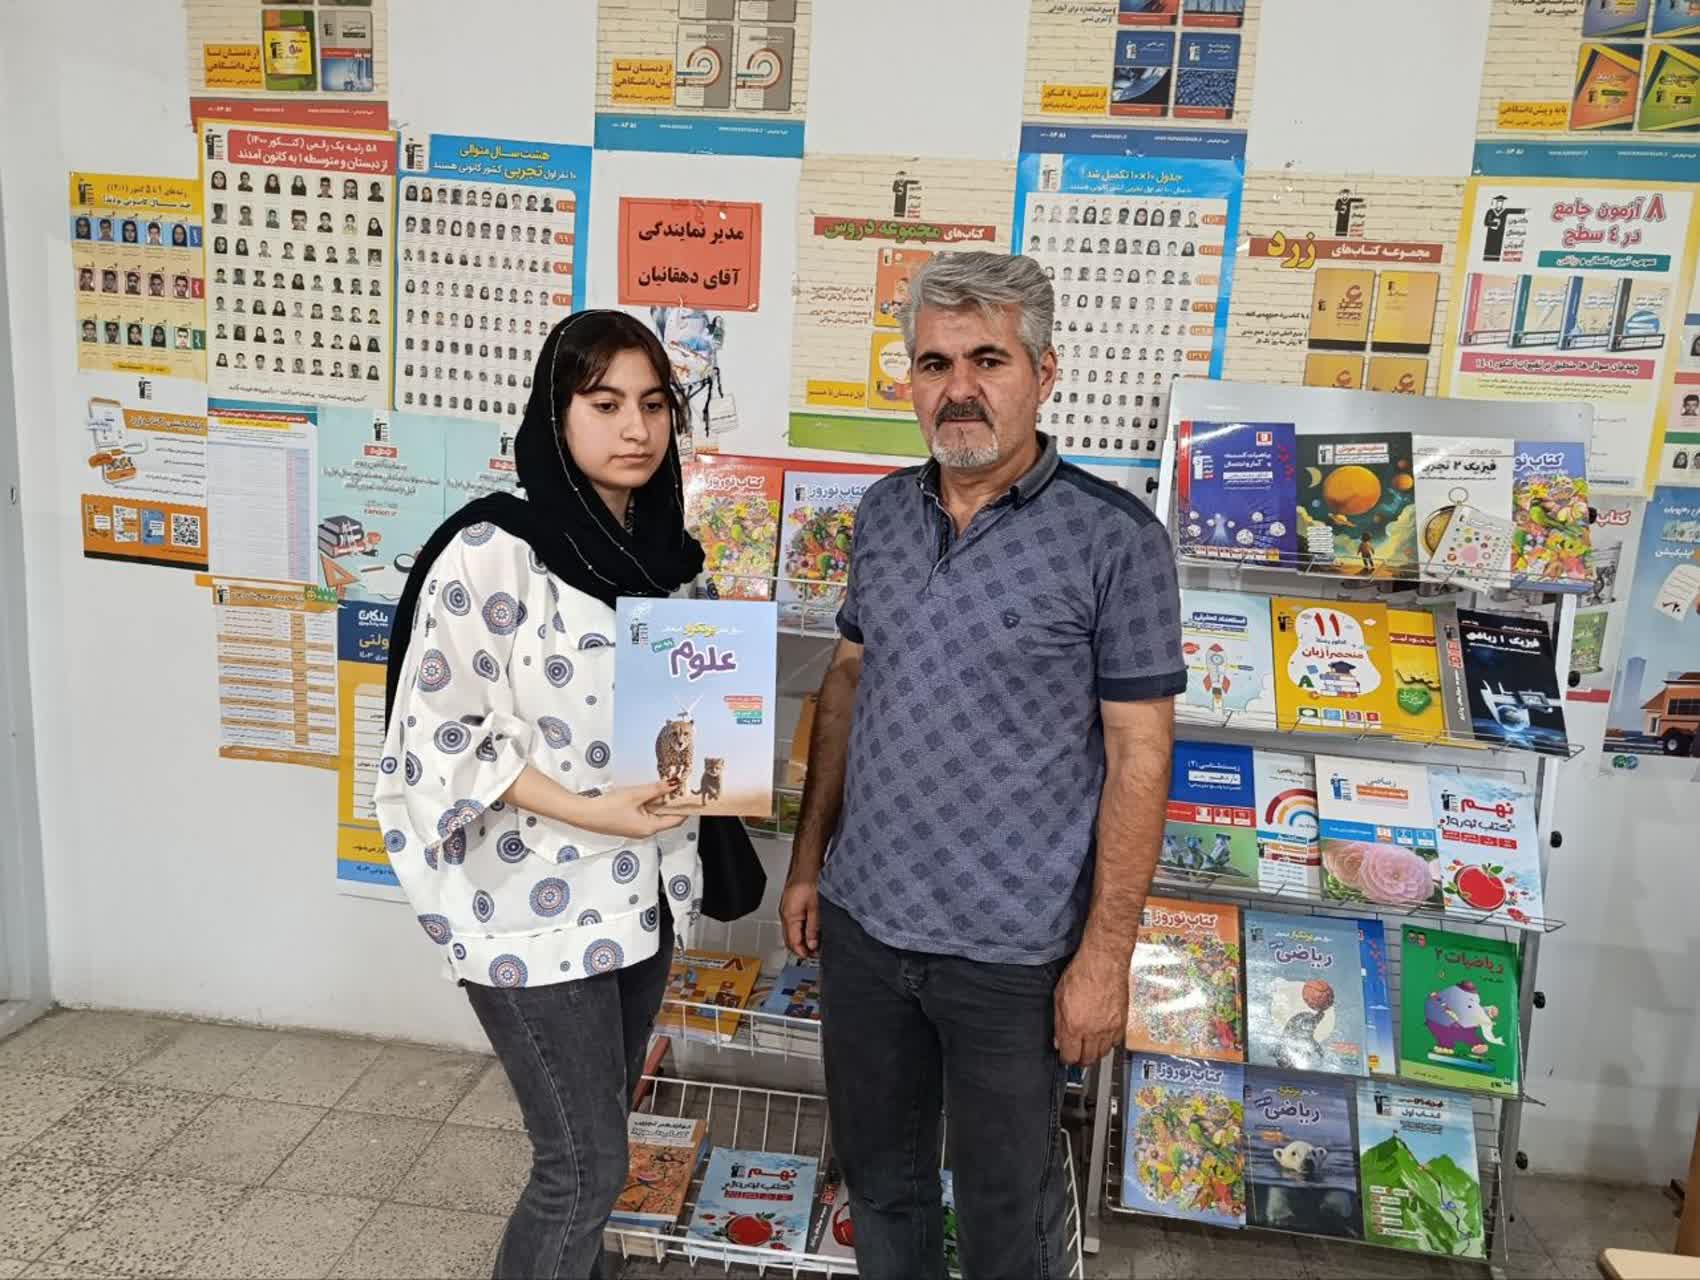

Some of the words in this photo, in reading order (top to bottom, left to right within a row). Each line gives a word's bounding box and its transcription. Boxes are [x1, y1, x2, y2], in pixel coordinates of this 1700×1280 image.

[504, 165, 544, 181] تجربی
[1551, 197, 1593, 223] جامع
[1596, 196, 1643, 223] آزمون
[1644, 193, 1667, 223] ۸
[638, 220, 706, 242] نمایندگی
[709, 227, 744, 244] مدیر
[1562, 224, 1605, 248] سطح
[1619, 228, 1642, 249] در
[1267, 230, 1317, 271] زرد
[1381, 244, 1431, 262] مجموعه
[638, 264, 699, 287] دهقانیان
[703, 267, 742, 290] آقای
[1422, 461, 1450, 474] تجربی
[1453, 461, 1461, 471] ۲
[1464, 459, 1497, 476] فیزیک
[1529, 453, 1564, 468] کتاب
[1313, 612, 1340, 638] ۱۱
[359, 633, 389, 649] ولتی
[1465, 630, 1498, 645] ریاضی
[1509, 636, 1541, 649] فیزیک
[669, 639, 738, 682] علوم
[1302, 646, 1325, 659] زبان
[1461, 798, 1514, 819] نهم
[1445, 815, 1477, 829] نوروز
[1152, 910, 1185, 928] نوروز
[1187, 913, 1217, 928] کتاب
[1275, 943, 1334, 969] ریاضی
[1445, 953, 1505, 975] ریاضیات
[1158, 1063, 1191, 1081] نوروز
[1193, 1069, 1225, 1084] کتاب
[1264, 1099, 1322, 1125] ریاضی
